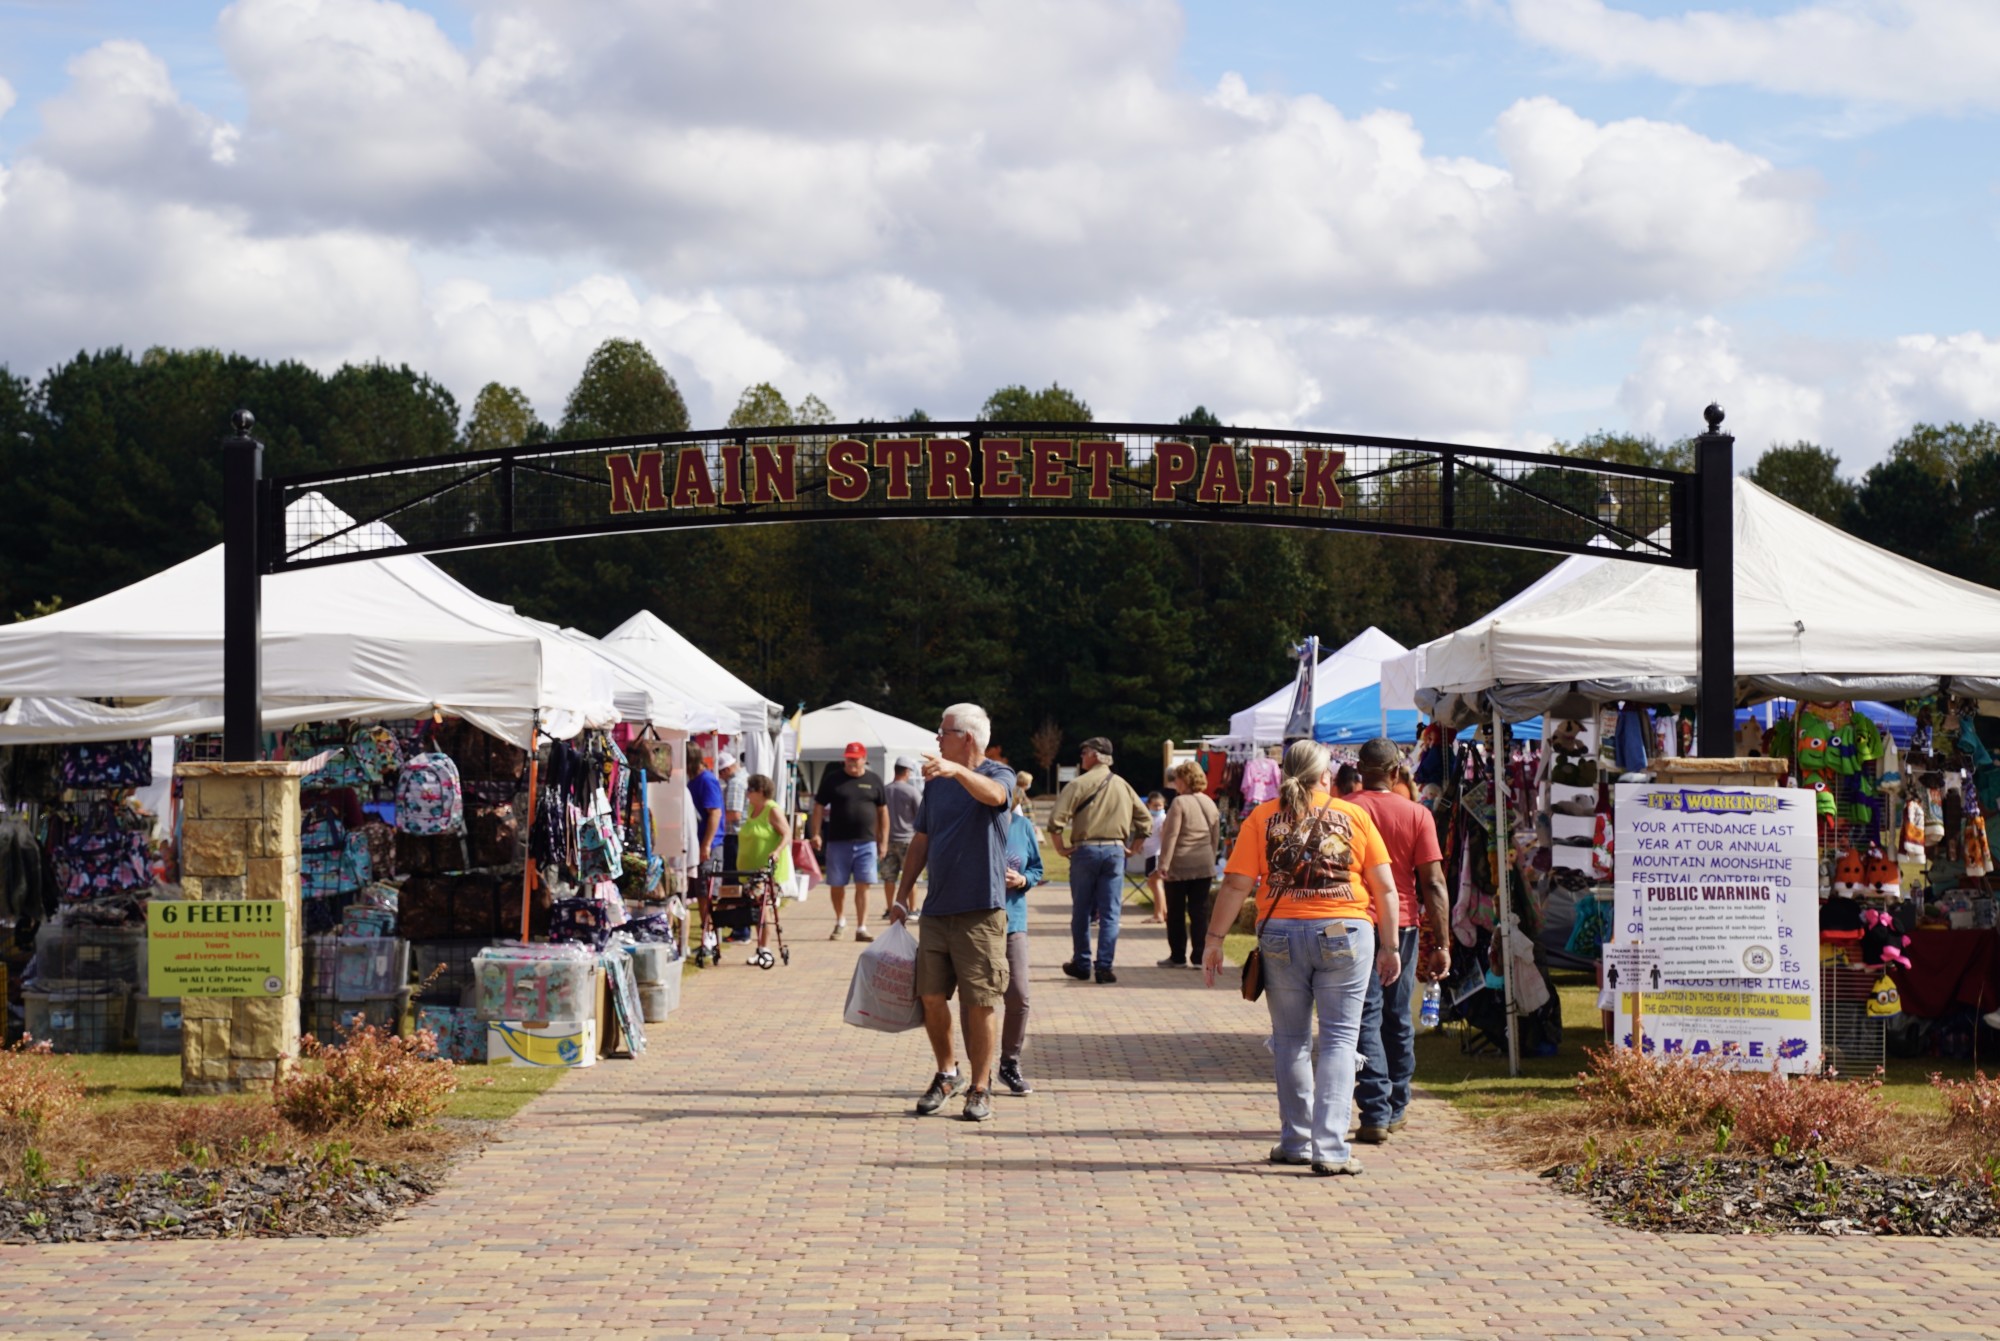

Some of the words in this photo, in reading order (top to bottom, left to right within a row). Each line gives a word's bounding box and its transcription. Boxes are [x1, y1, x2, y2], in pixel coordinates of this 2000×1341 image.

[606, 443, 799, 514] MAIN
[827, 438, 1125, 500] STREET
[1154, 442, 1347, 511] PARK
[1647, 793, 1681, 809] IT'S
[1686, 794, 1779, 811] WORKING!!
[1632, 821, 1666, 833] YOUR
[1671, 822, 1757, 835] ATTENDANCE
[1762, 824, 1794, 836] LAST
[1637, 838, 1669, 850] YEAR
[1674, 839, 1692, 850] AT
[1697, 839, 1723, 851] OUR
[1729, 841, 1782, 853] ANNUAL
[1632, 855, 1705, 868] MOUNTAIN
[1710, 857, 1792, 870] MOONSHINE
[1647, 885, 1699, 902] PUBLIC
[1702, 885, 1771, 901] WARNING
[1668, 904, 1693, 912] Georgia
[1743, 903, 1766, 912] liability
[162, 905, 177, 923] 6
[187, 904, 273, 923] FEET!!!
[1669, 914, 1687, 922] injury
[1734, 913, 1765, 921] individual
[1695, 924, 1725, 932] premises
[1748, 924, 1766, 932] injury
[153, 930, 180, 939] Social
[183, 930, 229, 940] Distancing
[232, 930, 257, 938] Saves
[259, 929, 281, 938] Lives
[205, 941, 230, 949] Yours
[174, 952, 192, 960] and
[194, 952, 233, 960] Everyone
[236, 951, 260, 959] Else's
[1676, 959, 1706, 967] assuming
[163, 965, 201, 973] Maintain
[203, 965, 222, 973] Safe
[225, 965, 271, 974] Distancing
[190, 975, 206, 983] ALL
[208, 975, 224, 984] City
[1664, 978, 1714, 988] ARIOUS
[1719, 978, 1763, 989] OTHER
[206, 985, 247, 993] Facilities.
[1699, 992, 1714, 1002] THIS
[1716, 993, 1737, 1003] YEAR'S
[1769, 995, 1785, 1005] WILL
[1786, 995, 1809, 1006] INSURE
[1644, 1004, 1656, 1014] THE
[1658, 1004, 1694, 1015] CONTINUED
[1695, 1006, 1721, 1015] SUCCESS
[1723, 1006, 1731, 1016] OF
[1734, 1007, 1745, 1016] OUR
